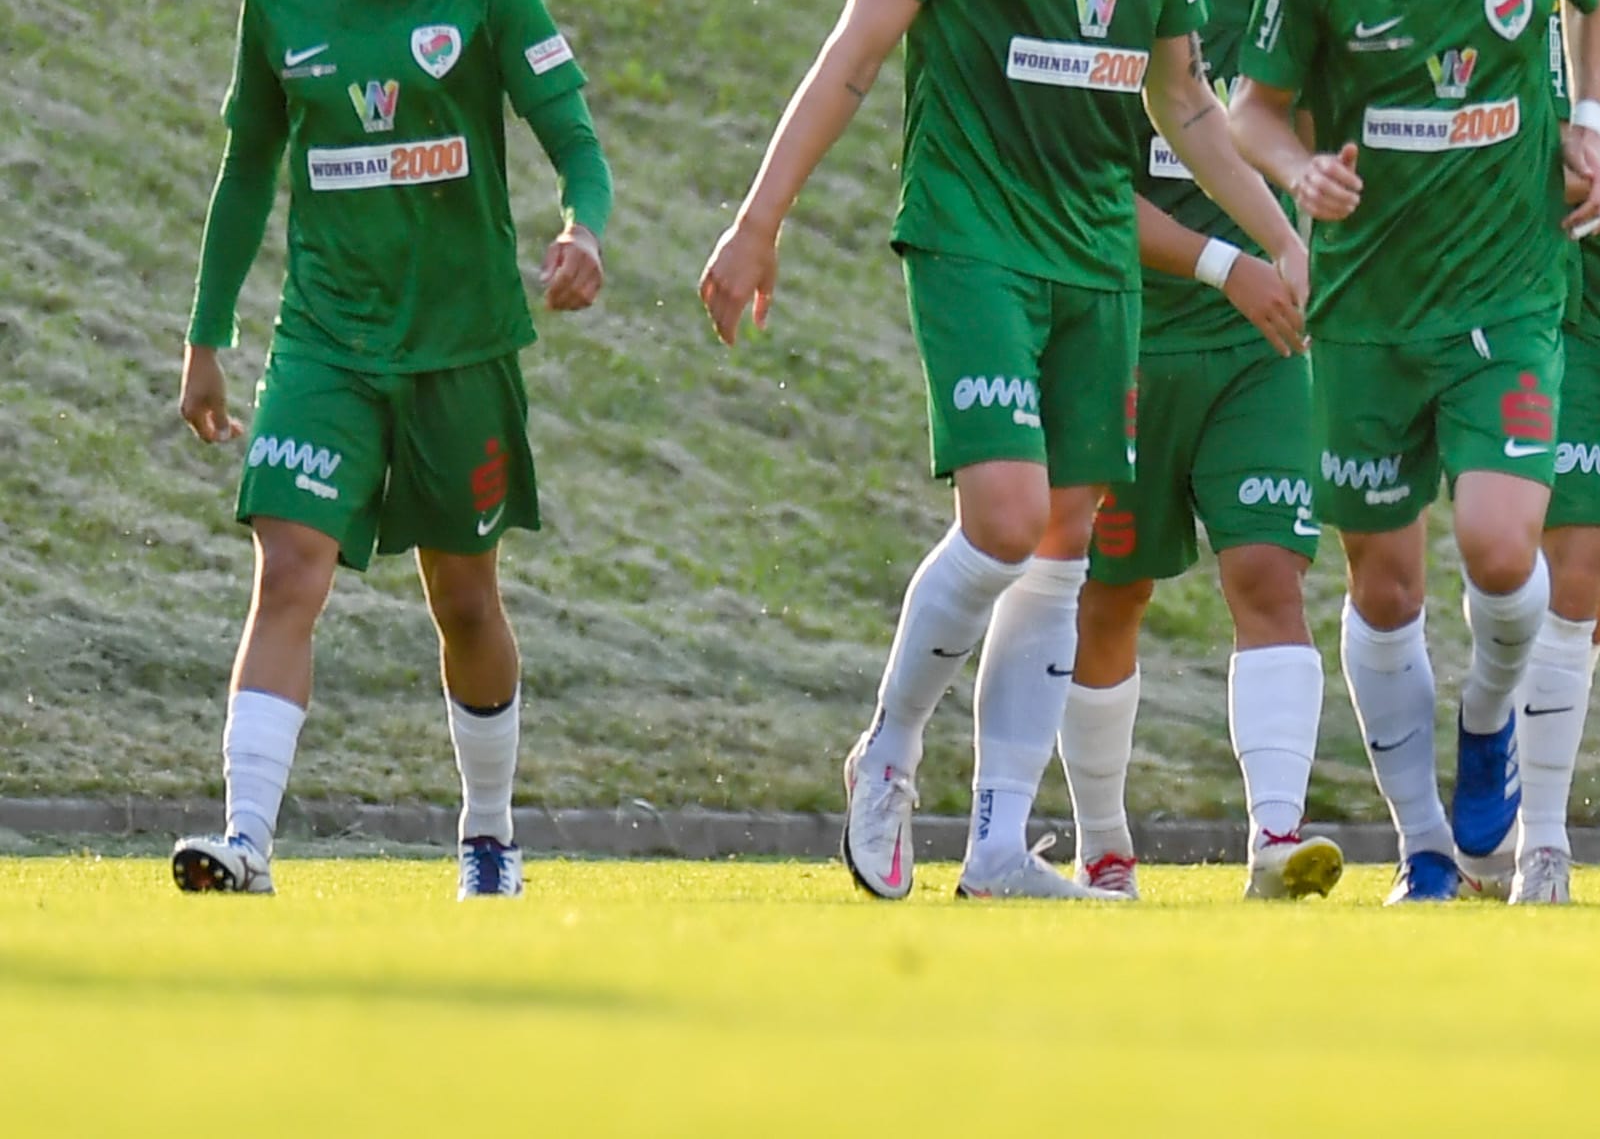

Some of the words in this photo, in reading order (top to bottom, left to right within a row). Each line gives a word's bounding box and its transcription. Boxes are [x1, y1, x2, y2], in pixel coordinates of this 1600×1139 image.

[1368, 120, 1448, 139] WOHNBAU
[1449, 103, 1516, 143] 2000
[311, 157, 389, 178] WOHNBAU
[390, 141, 464, 181] 2000
